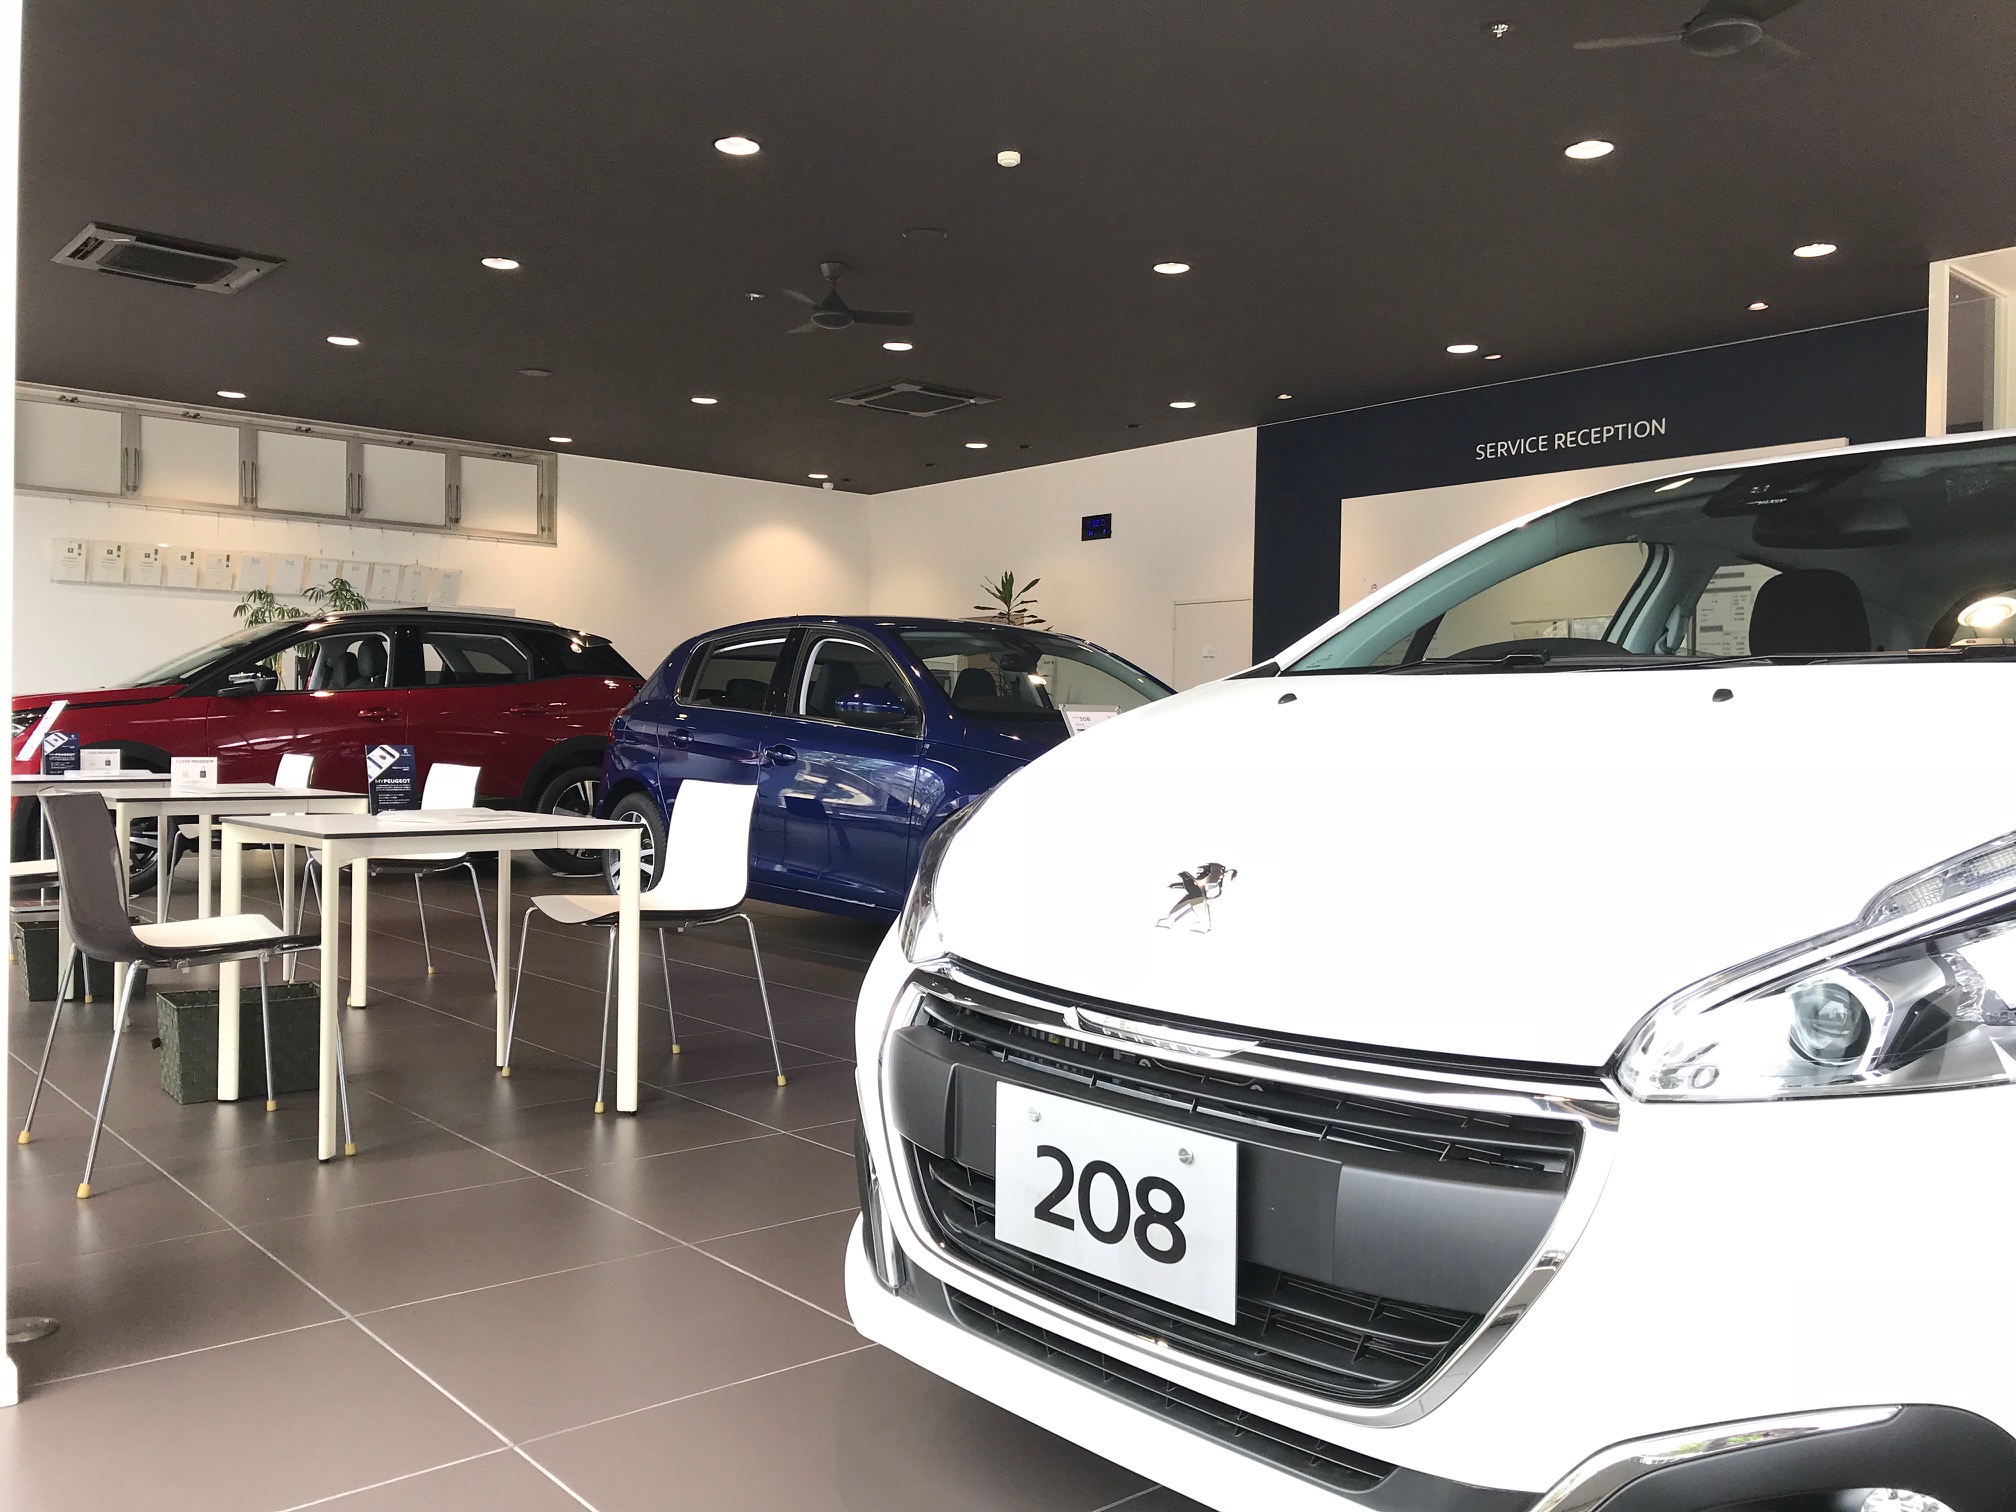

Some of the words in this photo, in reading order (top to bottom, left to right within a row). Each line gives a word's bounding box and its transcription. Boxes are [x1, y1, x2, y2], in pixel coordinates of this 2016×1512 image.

[1475, 435, 1548, 460] SERVICE
[1554, 417, 1666, 450] RECEPTION
[1034, 1144, 1187, 1264] 208
